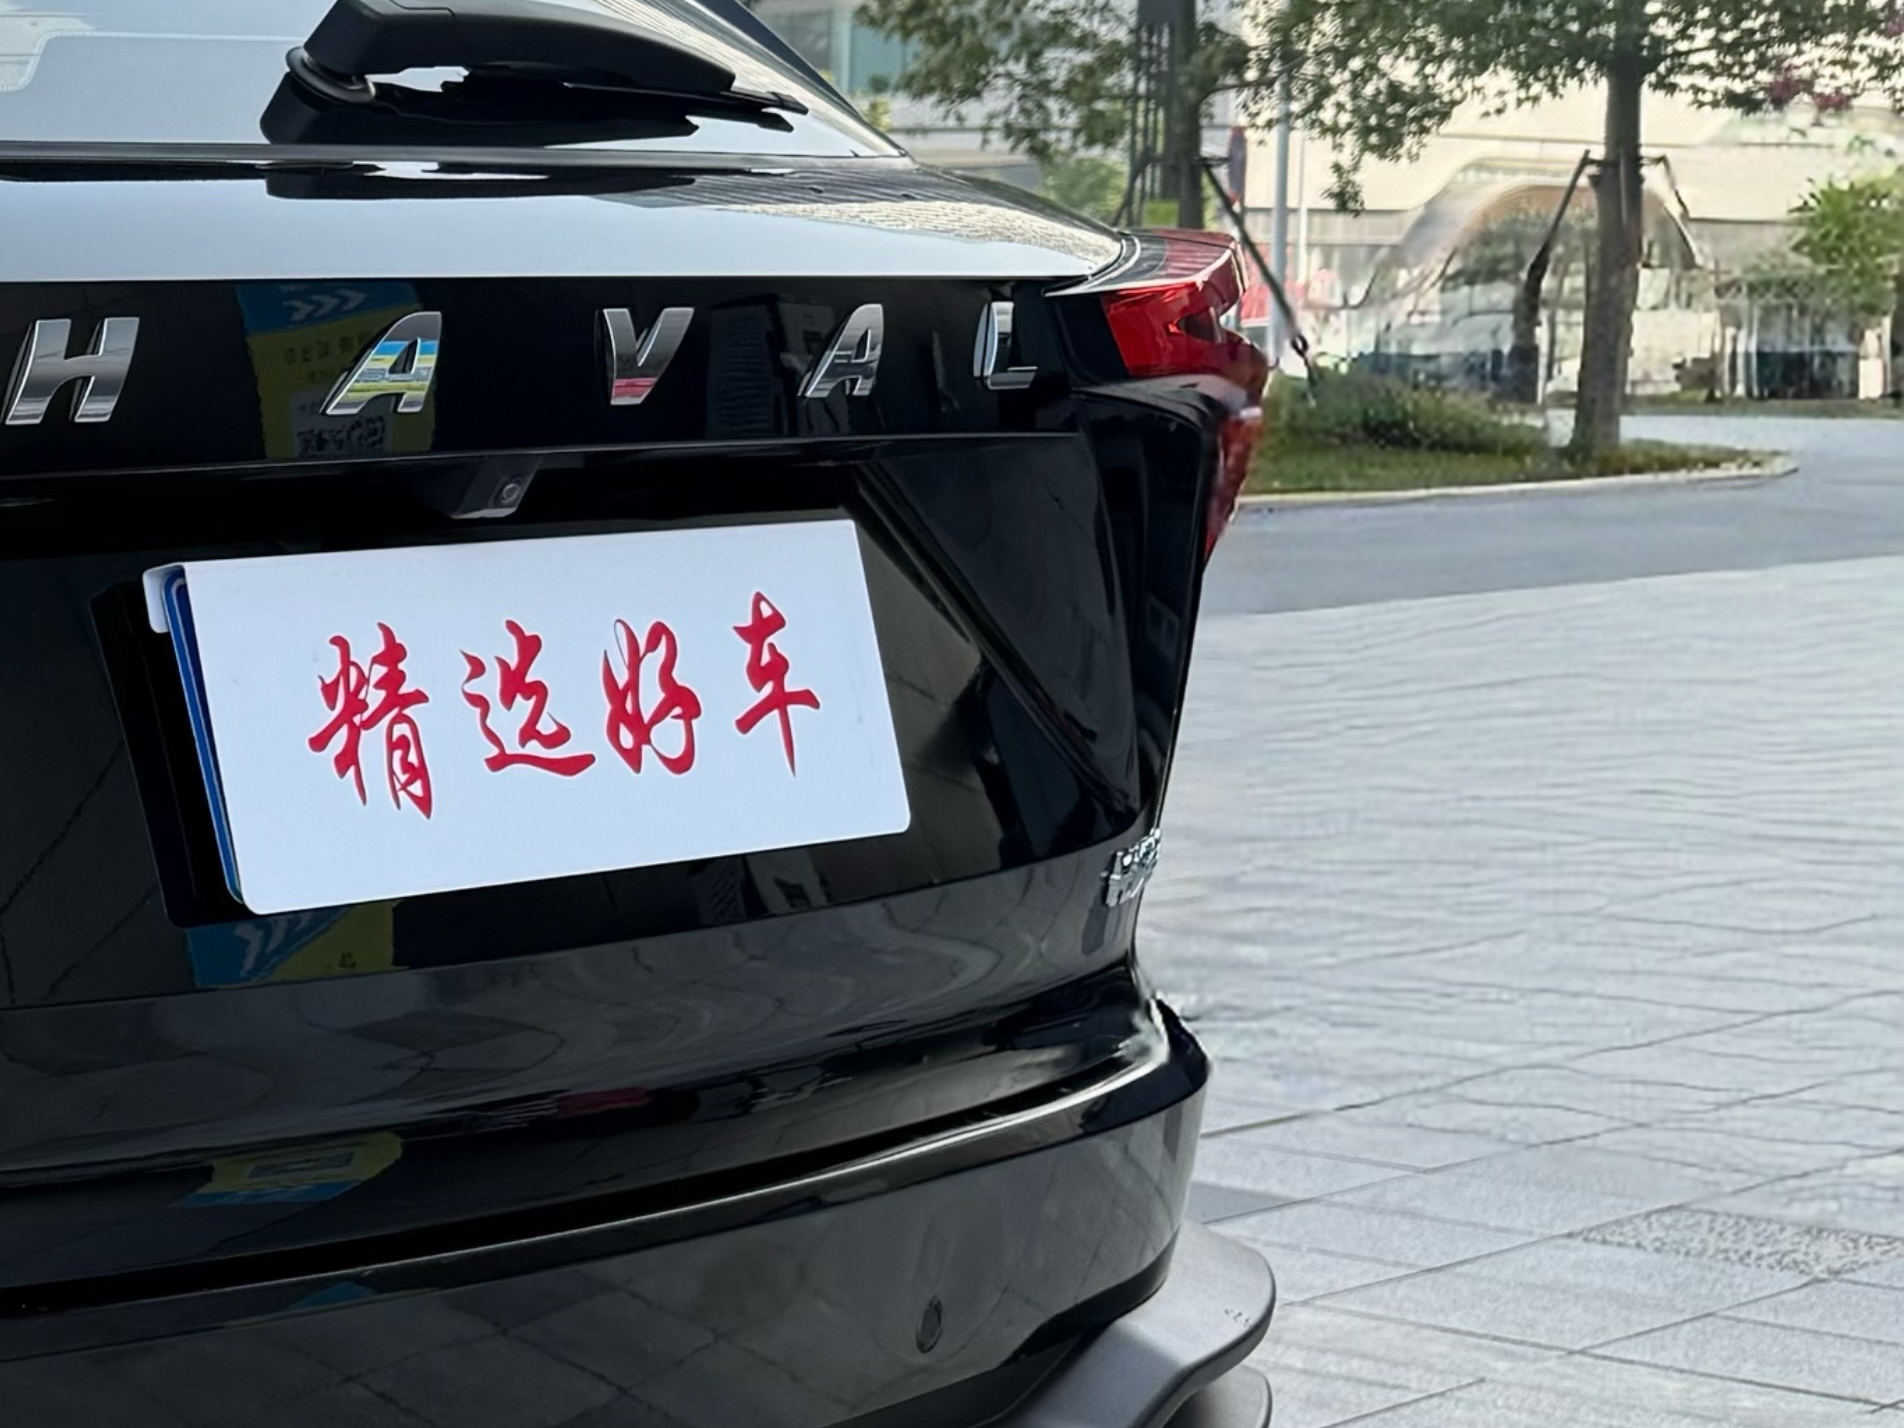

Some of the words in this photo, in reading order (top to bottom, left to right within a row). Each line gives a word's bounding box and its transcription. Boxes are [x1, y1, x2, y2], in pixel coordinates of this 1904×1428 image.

[2, 300, 1039, 427] HAVAL
[307, 590, 822, 820] 精选好车
